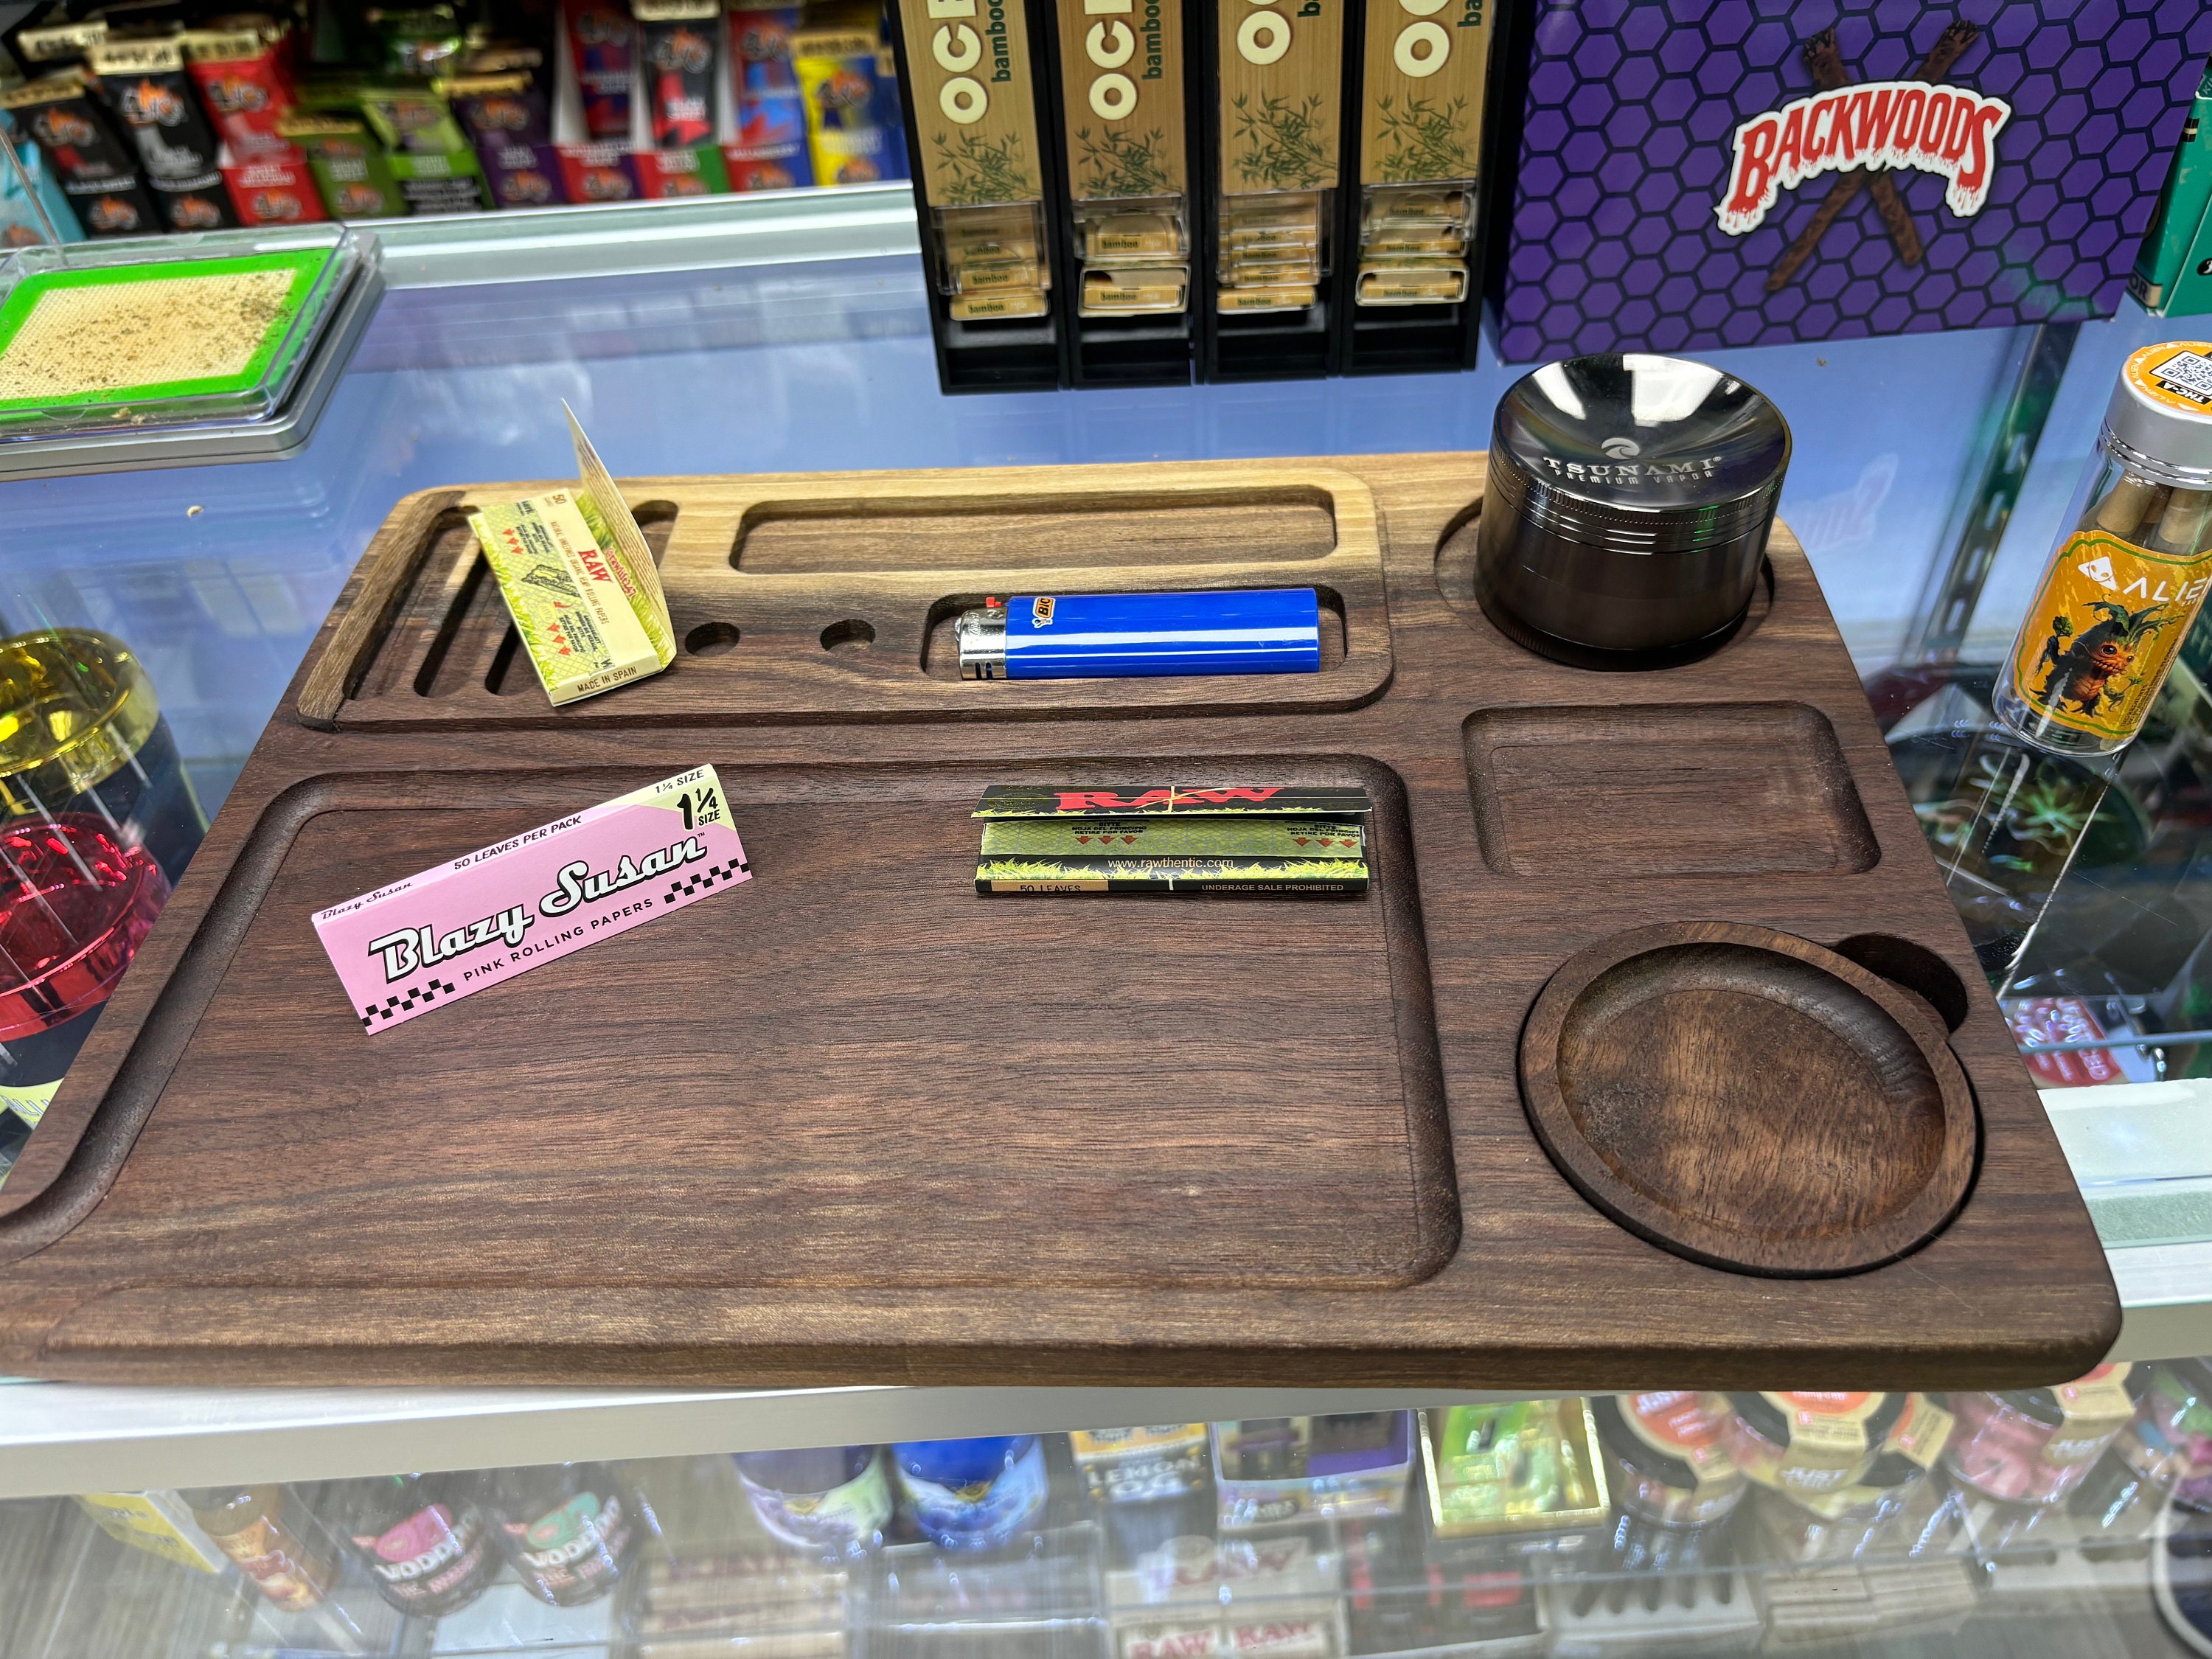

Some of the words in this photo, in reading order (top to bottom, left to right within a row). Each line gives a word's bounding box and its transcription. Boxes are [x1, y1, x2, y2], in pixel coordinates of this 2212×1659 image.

[1084, 0, 1138, 121] OC
[1719, 86, 2007, 232] BACKWOODS
[1101, 237, 1139, 249] bamboo
[1099, 290, 1137, 302] bamboo
[1237, 296, 1273, 307] bamboo
[967, 301, 1005, 313] bamboo
[2163, 382, 2205, 403] THC-A
[1554, 469, 1639, 484] PREMIUM
[1654, 470, 1713, 483] VAPOR
[552, 494, 567, 504] 50
[578, 549, 613, 582] RAW
[2123, 577, 2208, 602] ALIE
[585, 588, 601, 606] ROLLING
[594, 608, 610, 625] PAPERS
[1038, 598, 1051, 616] BIC
[577, 678, 601, 693] MADE
[601, 675, 611, 684] IN
[613, 667, 637, 681] SPAIN
[677, 769, 704, 786] SIZE
[1054, 787, 1284, 810] RAW
[698, 809, 721, 827] SIZE
[453, 858, 471, 871] 50
[474, 838, 519, 863] LEAVES
[523, 829, 548, 846] PER
[550, 815, 582, 838] PACK
[1107, 857, 1234, 868] www.rawthentic.com
[1285, 883, 1343, 891] PROHIBITED
[321, 899, 364, 921] Blazy
[366, 881, 414, 904] Susan
[367, 905, 535, 984] Blazy
[463, 959, 504, 982] PINK
[510, 925, 585, 963] ROLLING
[591, 897, 654, 929] PAPERS
